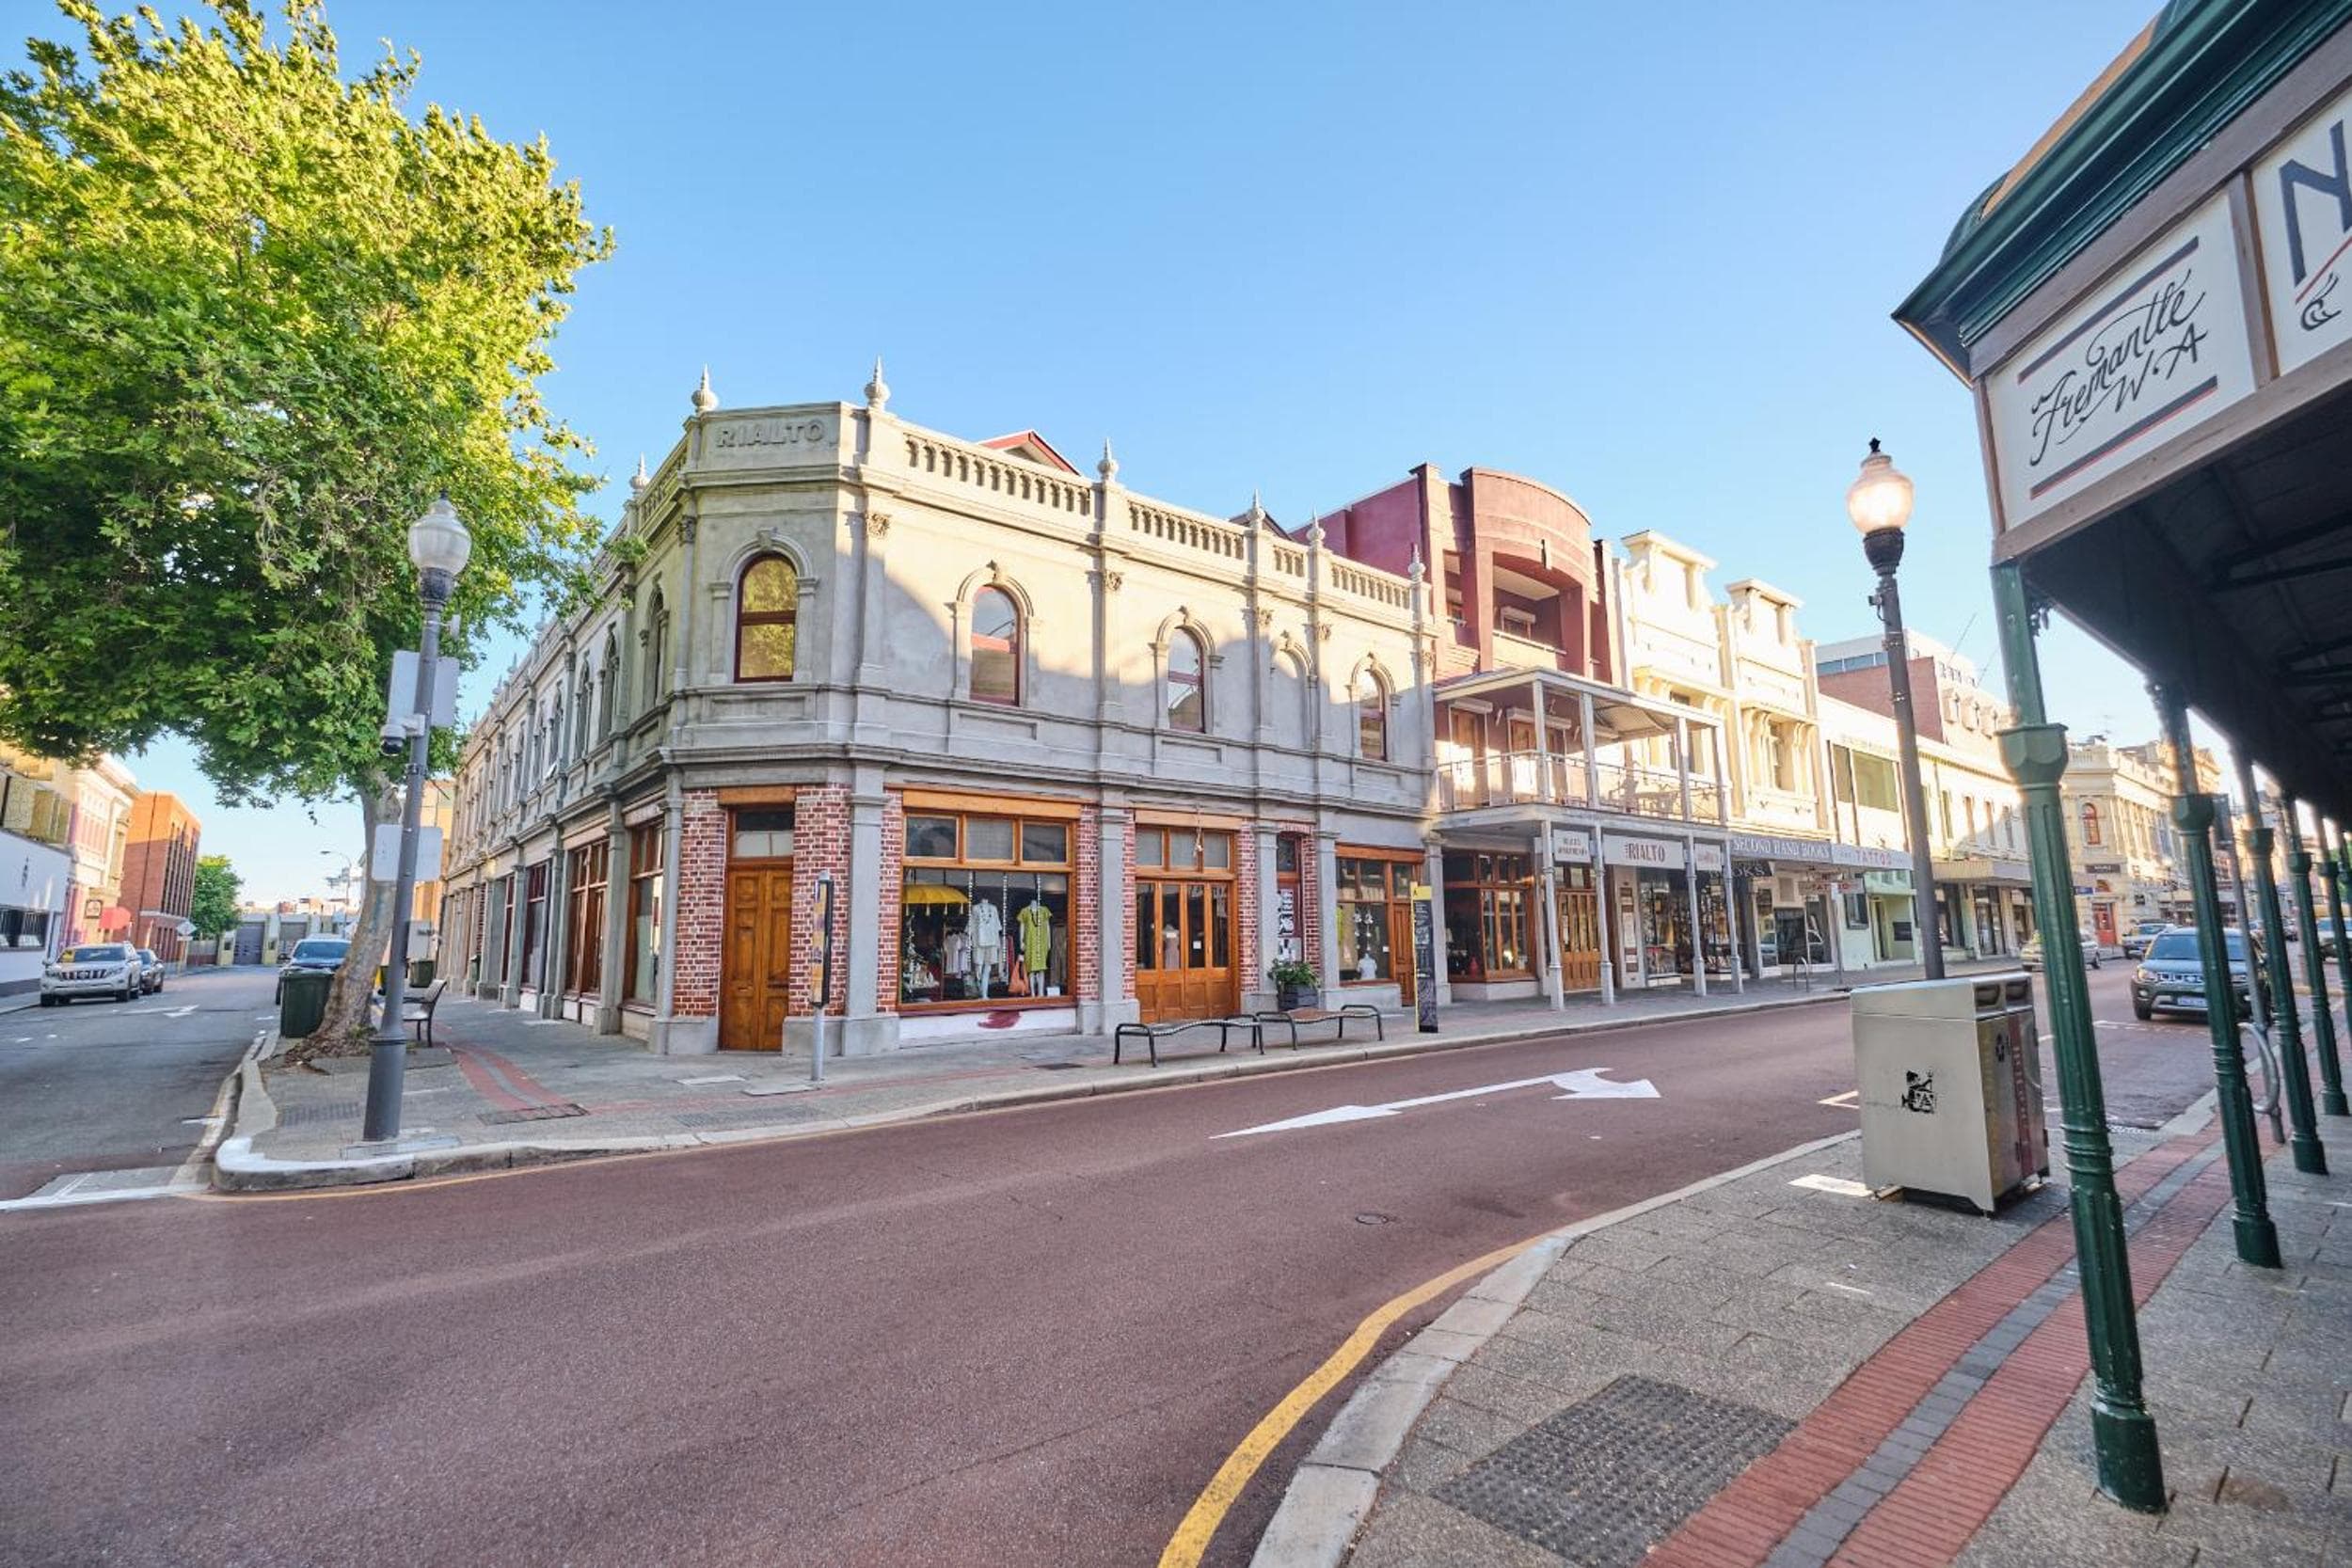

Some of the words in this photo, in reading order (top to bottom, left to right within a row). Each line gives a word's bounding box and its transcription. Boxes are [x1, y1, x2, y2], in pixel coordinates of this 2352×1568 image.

[2029, 268, 2206, 467] Fremantle
[716, 418, 825, 448] RIALTO
[1628, 843, 1666, 863] RIALTO
[1732, 836, 1771, 854] SECOND
[1773, 838, 1800, 856] HAND
[1802, 840, 1831, 859] BOOKS
